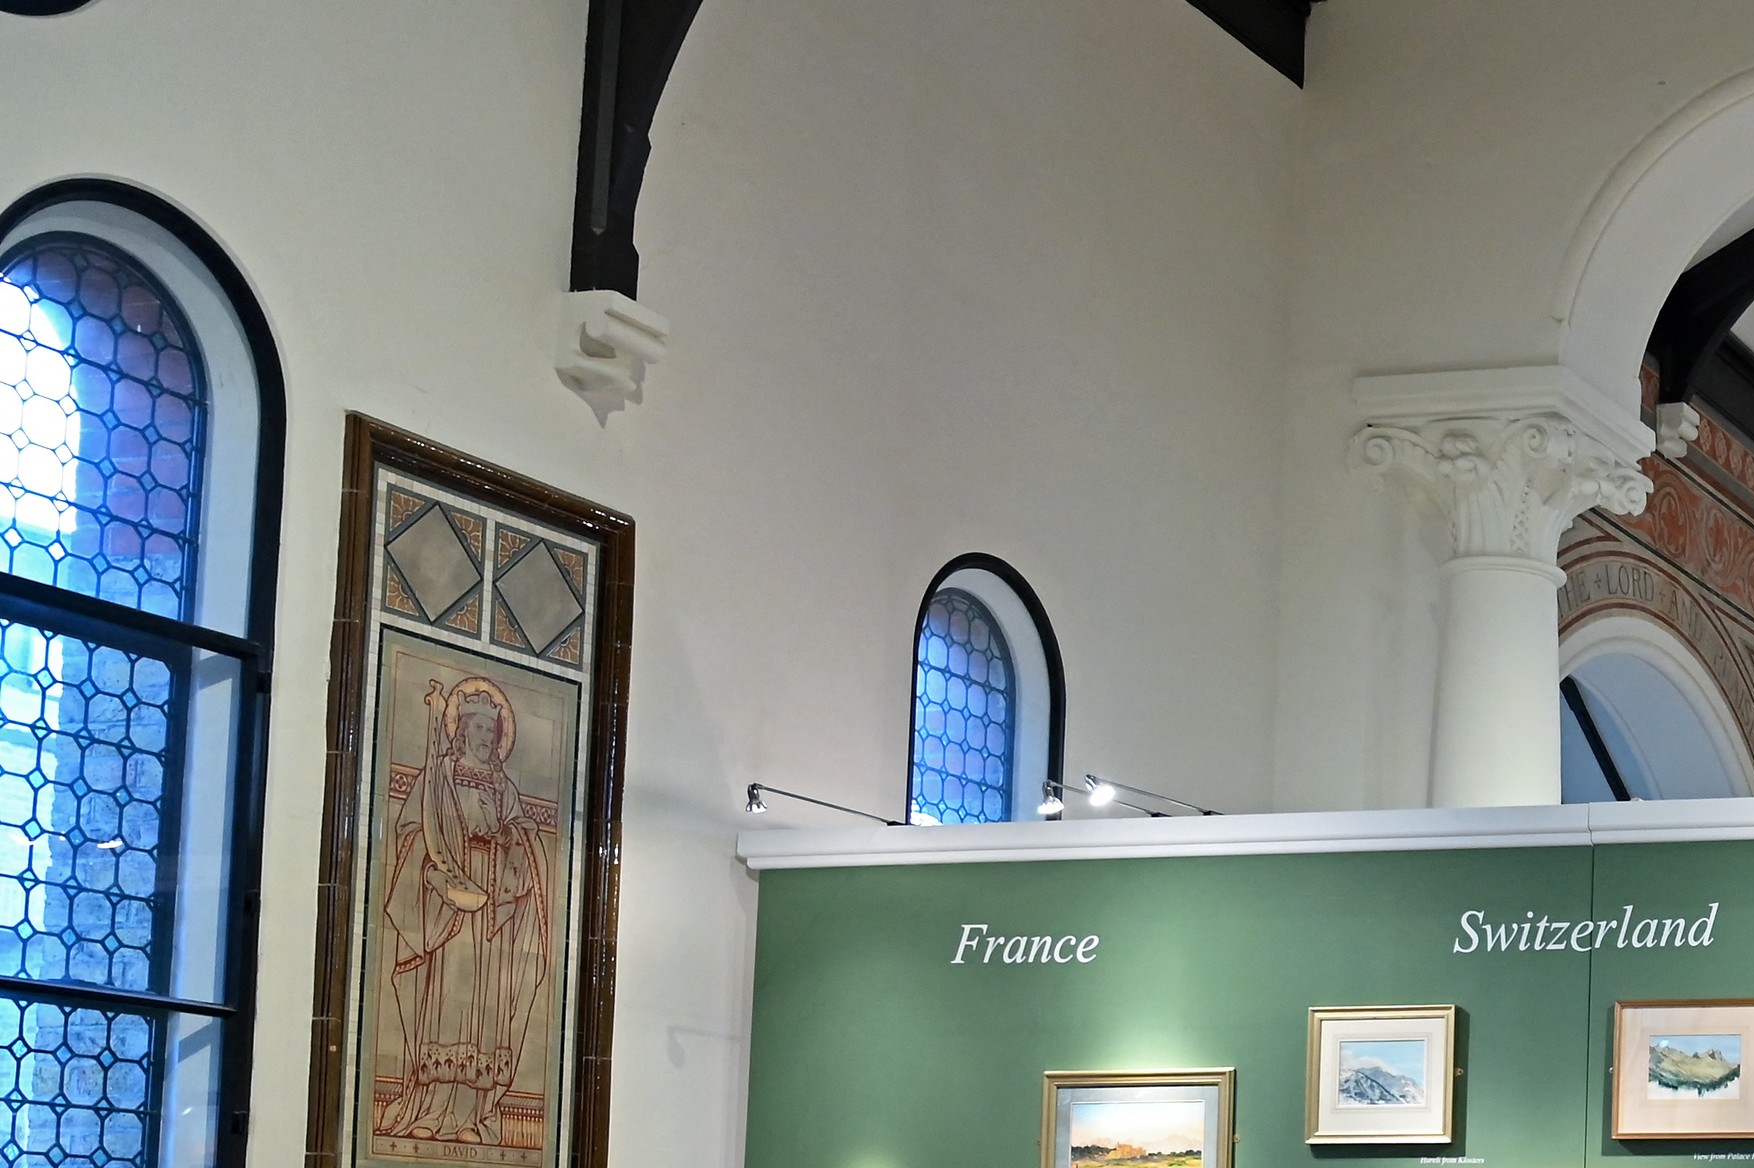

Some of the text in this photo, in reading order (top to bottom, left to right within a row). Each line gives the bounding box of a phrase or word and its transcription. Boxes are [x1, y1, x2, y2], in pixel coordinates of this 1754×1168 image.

[1605, 564, 1655, 601] LORD
[1668, 589, 1705, 641] AND
[1453, 902, 1719, 953] Switzerland
[950, 924, 1100, 964] France
[443, 1145, 478, 1158] DAVID
[1458, 1156, 1485, 1164] Klosters
[1693, 1152, 1708, 1160] View
[1709, 1152, 1726, 1162] from
[1727, 1152, 1750, 1160] Palace
